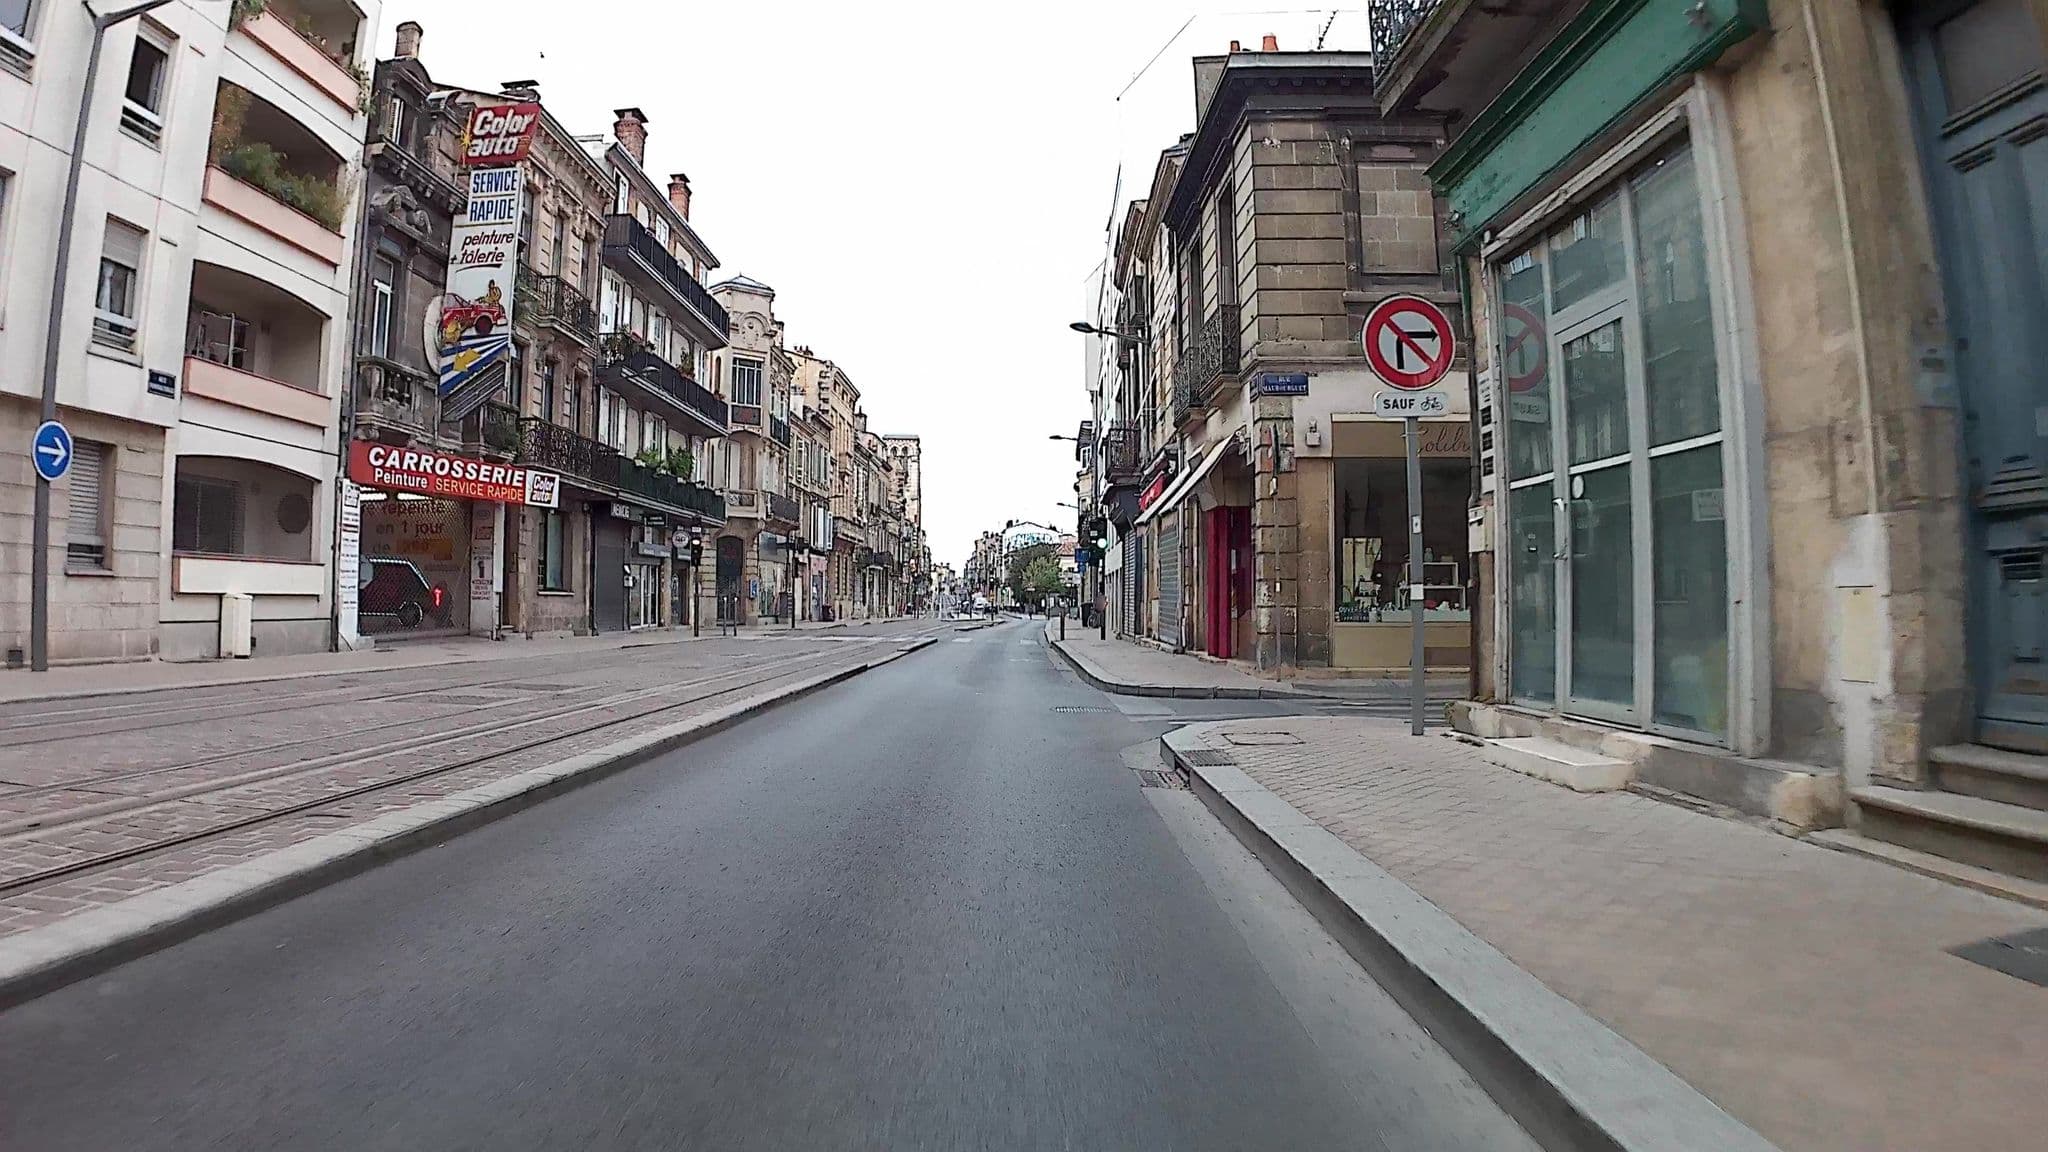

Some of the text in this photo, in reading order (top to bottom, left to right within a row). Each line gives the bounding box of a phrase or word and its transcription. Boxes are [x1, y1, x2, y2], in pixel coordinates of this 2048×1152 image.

[473, 108, 535, 136] Color
[468, 136, 518, 157] auto
[472, 170, 518, 193] SERVICE
[470, 199, 515, 222] RAPIDE
[461, 230, 515, 251] peinture
[460, 247, 505, 264] tôlerie
[1383, 398, 1415, 409] SAUF
[369, 446, 525, 487] CARROSSERIE
[374, 468, 524, 502] Peinture SERVICE RAPIDE
[534, 475, 554, 491] Color
[532, 489, 549, 502] auto
